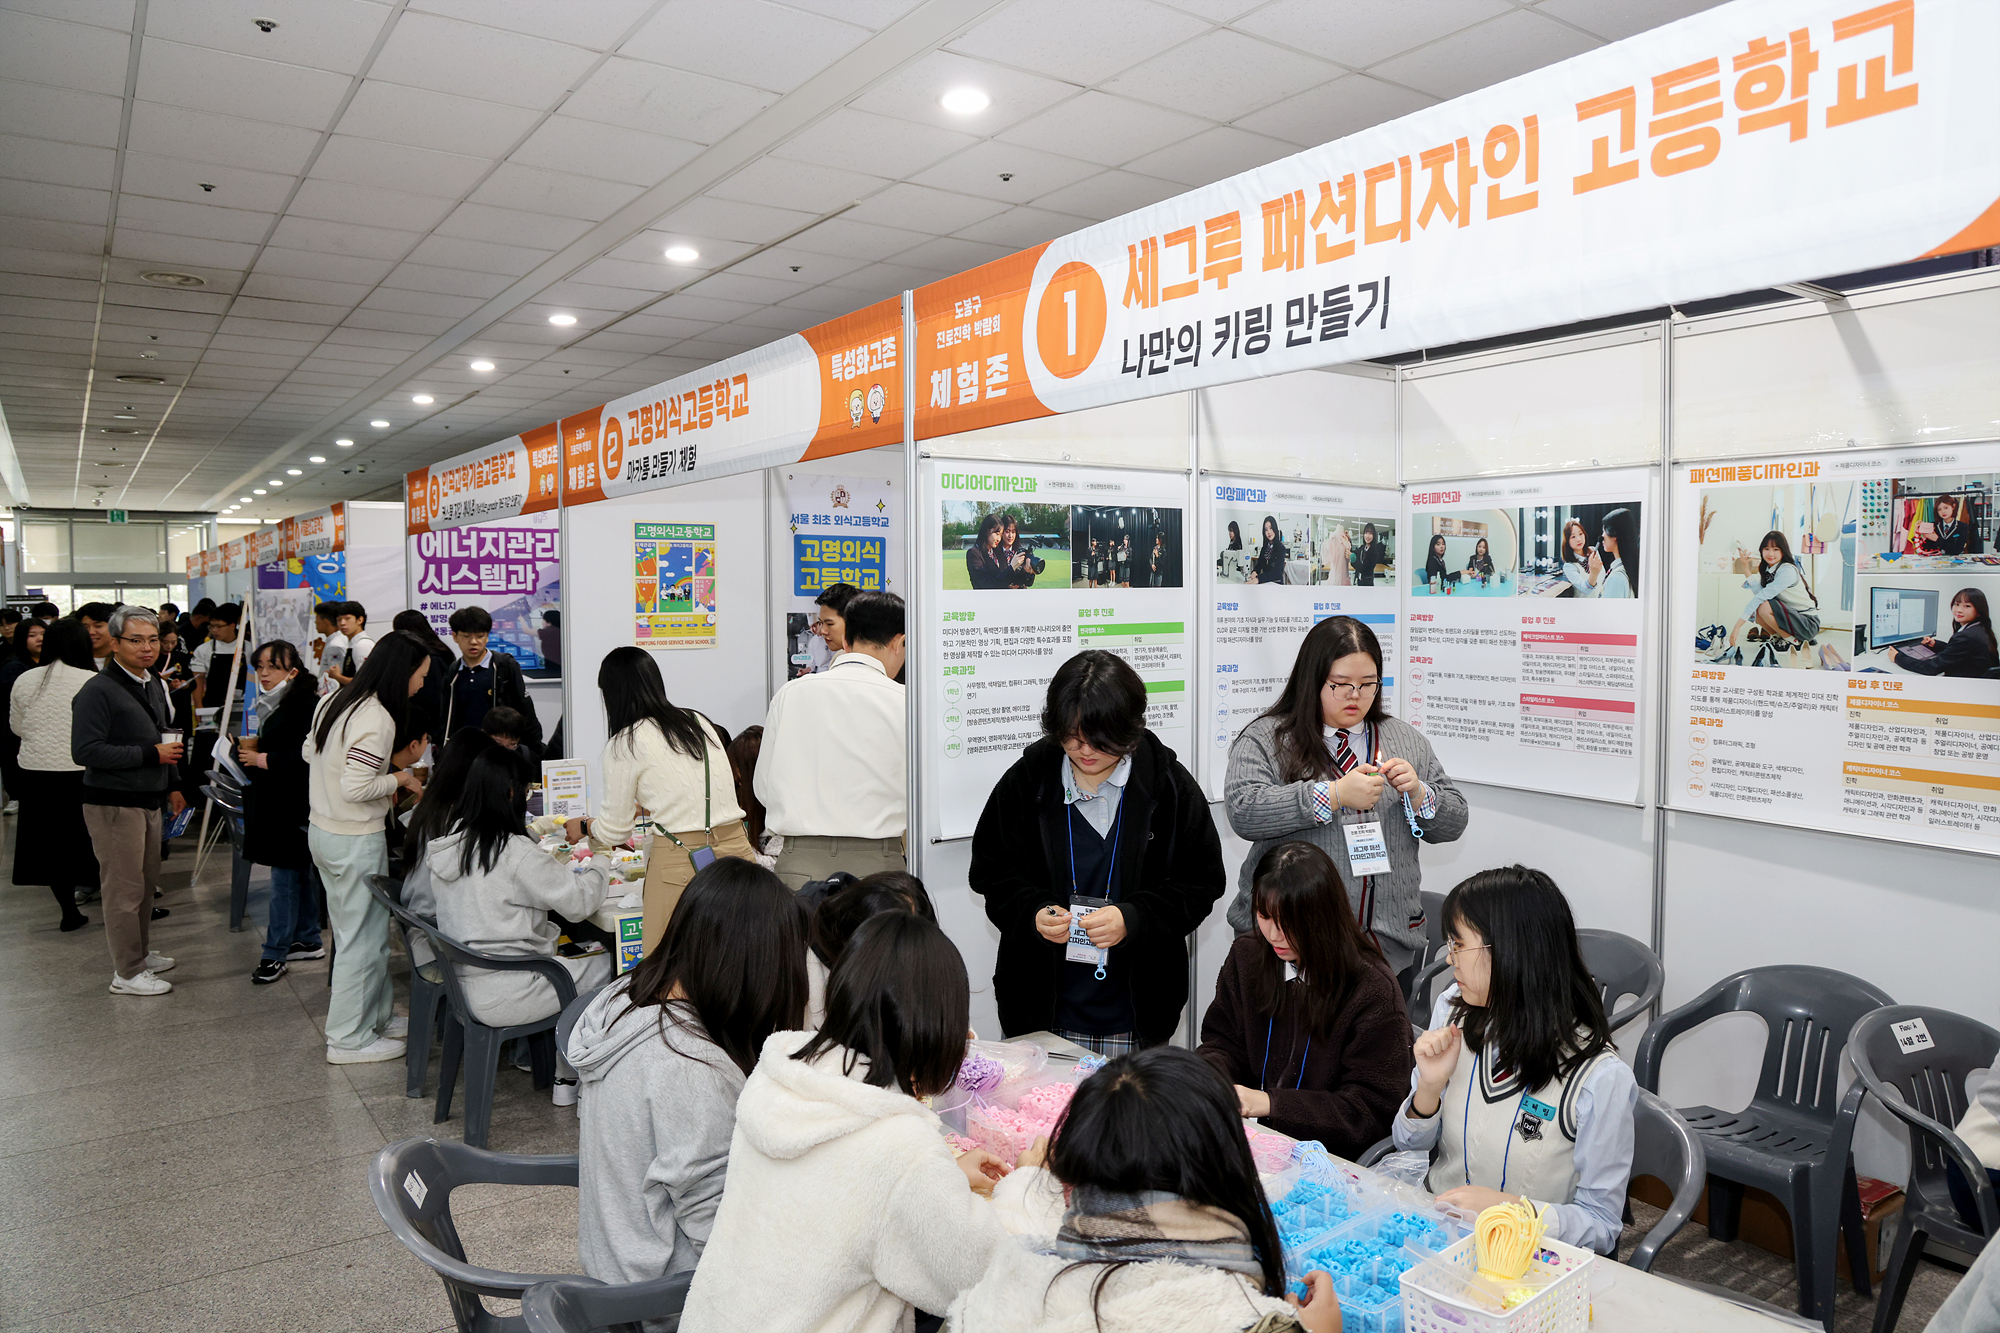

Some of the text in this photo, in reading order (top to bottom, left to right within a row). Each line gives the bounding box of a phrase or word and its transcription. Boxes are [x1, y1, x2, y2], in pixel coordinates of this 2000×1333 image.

[1122, 1, 1919, 310] 세그루 패션디자인 고등학교
[954, 295, 982, 320] 도봉구
[1061, 289, 1077, 356] 1
[1121, 275, 1391, 379] 나만의 키링 만들기
[936, 313, 1001, 350] 진로진학 박람회
[830, 336, 897, 383] 특성화고존
[627, 372, 750, 449] 고명외식고등학교
[608, 431, 618, 469] 2
[532, 445, 558, 469] 특성화고존
[1905, 457, 1943, 465] 캐릭터디자이너
[626, 444, 697, 484] 마카롱 만들기 체험
[1689, 461, 1820, 484] 패션제품디자인과
[942, 473, 1038, 492] 미디어디자인과
[432, 486, 438, 510] 3
[1216, 486, 1266, 503] 의상패션과
[1412, 491, 1462, 506] 뷰티패션과
[790, 514, 889, 527] 서울 최초 외식고등학교
[638, 526, 712, 538] 고명외식고등학교
[421, 530, 559, 559] 에너지관리
[800, 539, 880, 564] 고명외식
[422, 564, 535, 591] 시스템과
[800, 568, 880, 590] 고등학교
[430, 602, 456, 610] 에너지
[1216, 602, 1238, 611] 교육방향
[943, 612, 975, 621] 교육방향
[1079, 608, 1114, 617] 졸업 후 진로
[960, 627, 982, 635] 방송연기,
[950, 651, 965, 659] 영상을
[967, 650, 982, 659] 제작할
[1410, 656, 1433, 664] 교육과정
[943, 666, 975, 676] 교육과정
[1216, 664, 1238, 673] 교육과정
[1692, 670, 1726, 680] 교육방향
[1848, 679, 1903, 691] 졸업 후 진로
[1723, 687, 1745, 695] 교사로만
[1747, 688, 1764, 696] 구성된
[1766, 689, 1784, 697] 학과로
[1785, 691, 1809, 699] 체계적인
[1850, 699, 1885, 707] 제품디자이너
[1690, 717, 1723, 727] 교육과정
[1849, 723, 1927, 736] 제품디자인과, 산업디자인과,
[1934, 730, 1975, 740] 제품디자이너,
[1848, 732, 1891, 742] 주얼리디자인과,
[1894, 736, 1918, 744] 공예학과
[947, 742, 960, 750] 3학년
[1934, 739, 1978, 750] 주얼리디자이너,
[1846, 764, 1888, 776] 캐릭터디자이너
[1845, 789, 1885, 800] 캐릭터디자인과,
[1844, 798, 1878, 808] 애니메이션과,
[1880, 802, 1915, 813] 시각디자인과
[1930, 799, 1979, 812] 캐릭터디자이너,
[1929, 808, 1974, 821] 애니메이션 작가,
[1928, 818, 1972, 829] 일러스트레이터
[1351, 851, 1386, 860] 디자인고등학교
